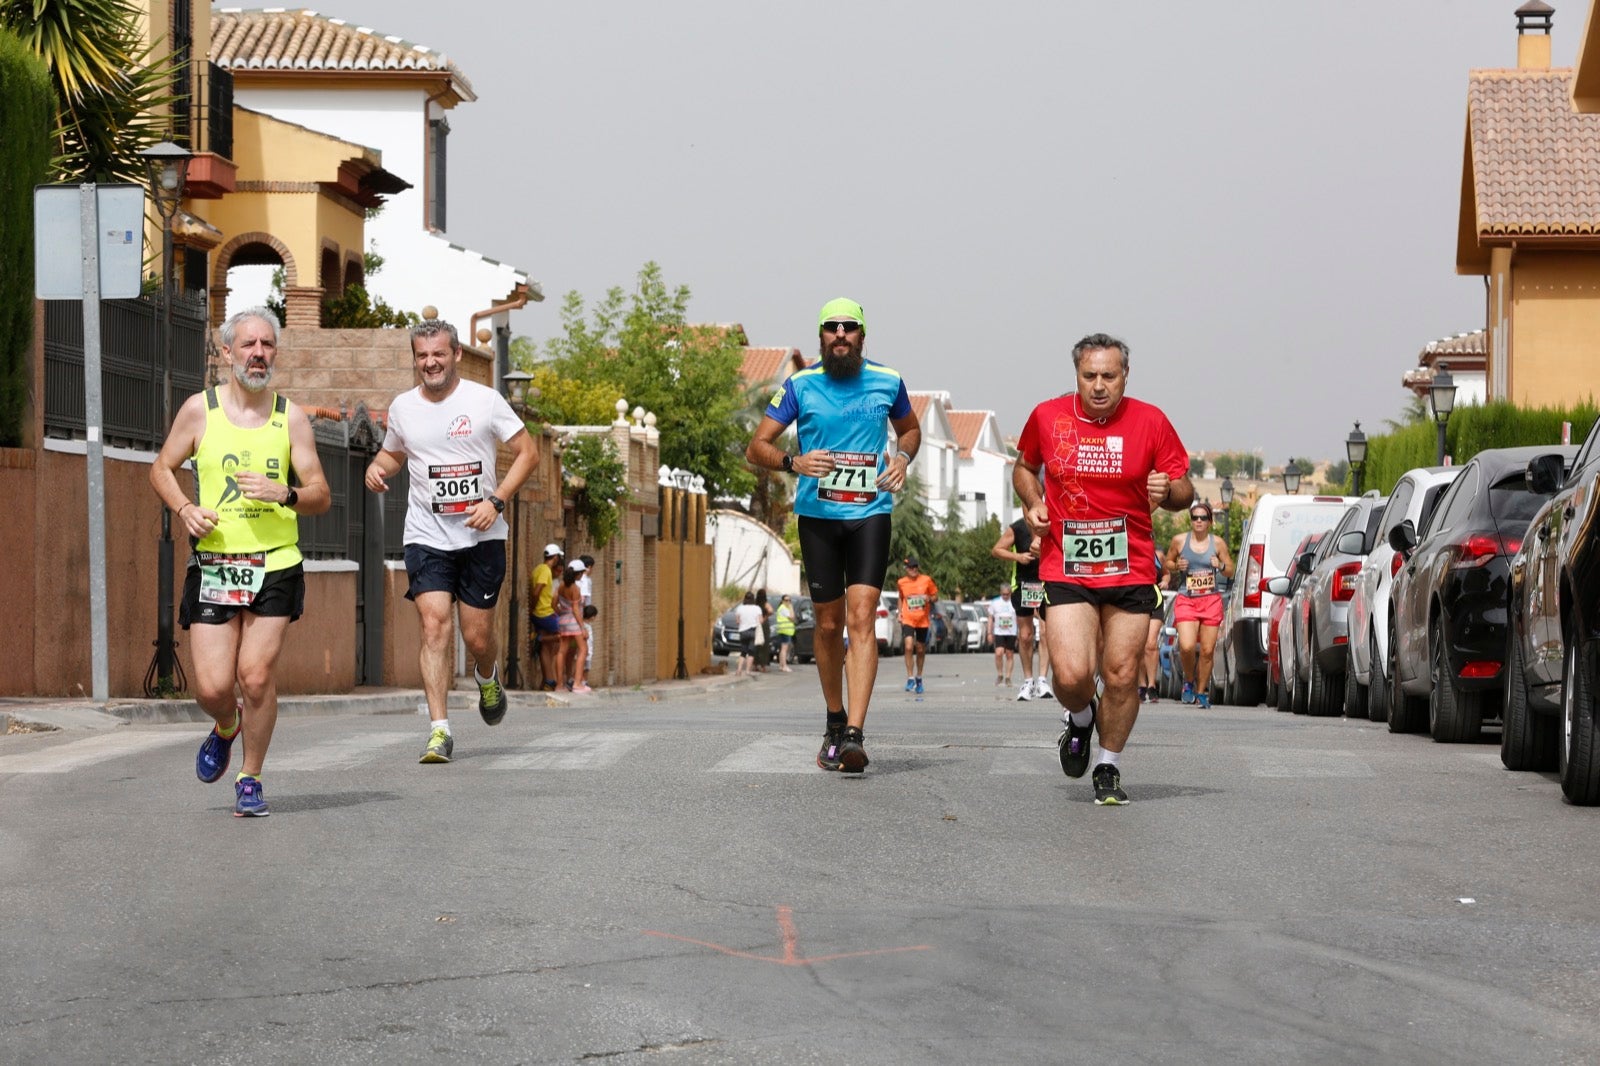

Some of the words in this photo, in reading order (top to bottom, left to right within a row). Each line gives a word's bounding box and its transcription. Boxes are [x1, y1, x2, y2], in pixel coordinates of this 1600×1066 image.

[1077, 452, 1122, 460] MARATÓN
[451, 464, 465, 472] PREMIO
[1076, 466, 1122, 474] GRANADA
[832, 468, 867, 488] 771
[436, 477, 479, 497] 3061
[1088, 521, 1104, 529] PREMIO
[1110, 519, 1123, 527] FONDO
[1074, 536, 1116, 558] 261
[215, 566, 254, 586] 188
[1191, 577, 1213, 588] 2042
